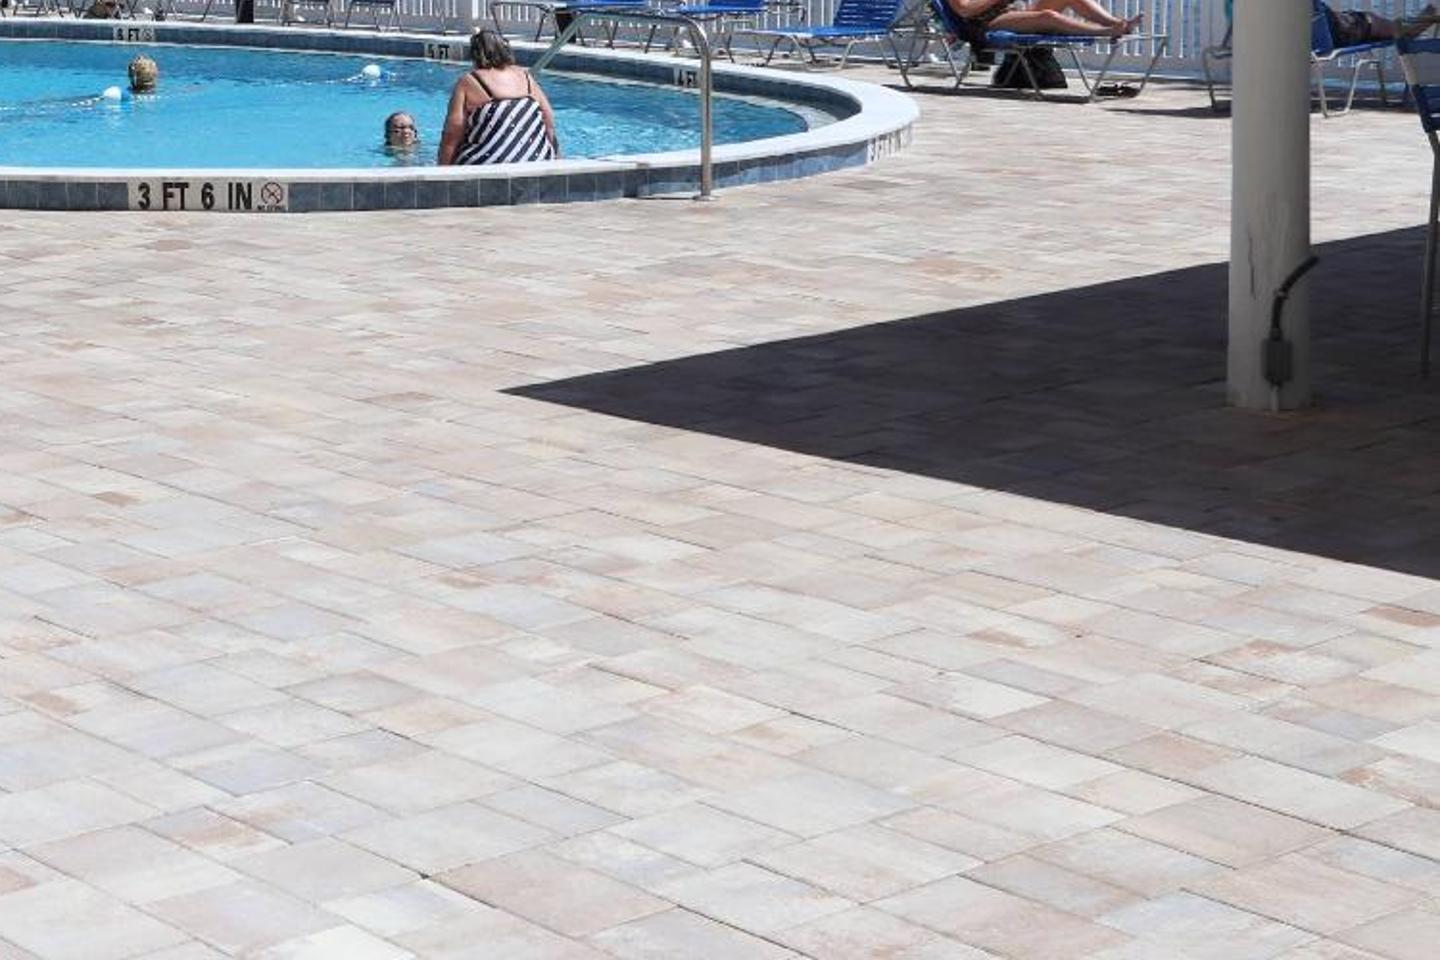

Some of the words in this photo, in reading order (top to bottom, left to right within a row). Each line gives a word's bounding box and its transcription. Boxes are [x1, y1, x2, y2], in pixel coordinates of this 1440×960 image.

[128, 28, 140, 41] FT
[438, 44, 450, 59] FT
[137, 182, 151, 210] 3
[162, 182, 189, 210] FT
[201, 182, 215, 210] 6
[228, 182, 253, 210] IN
